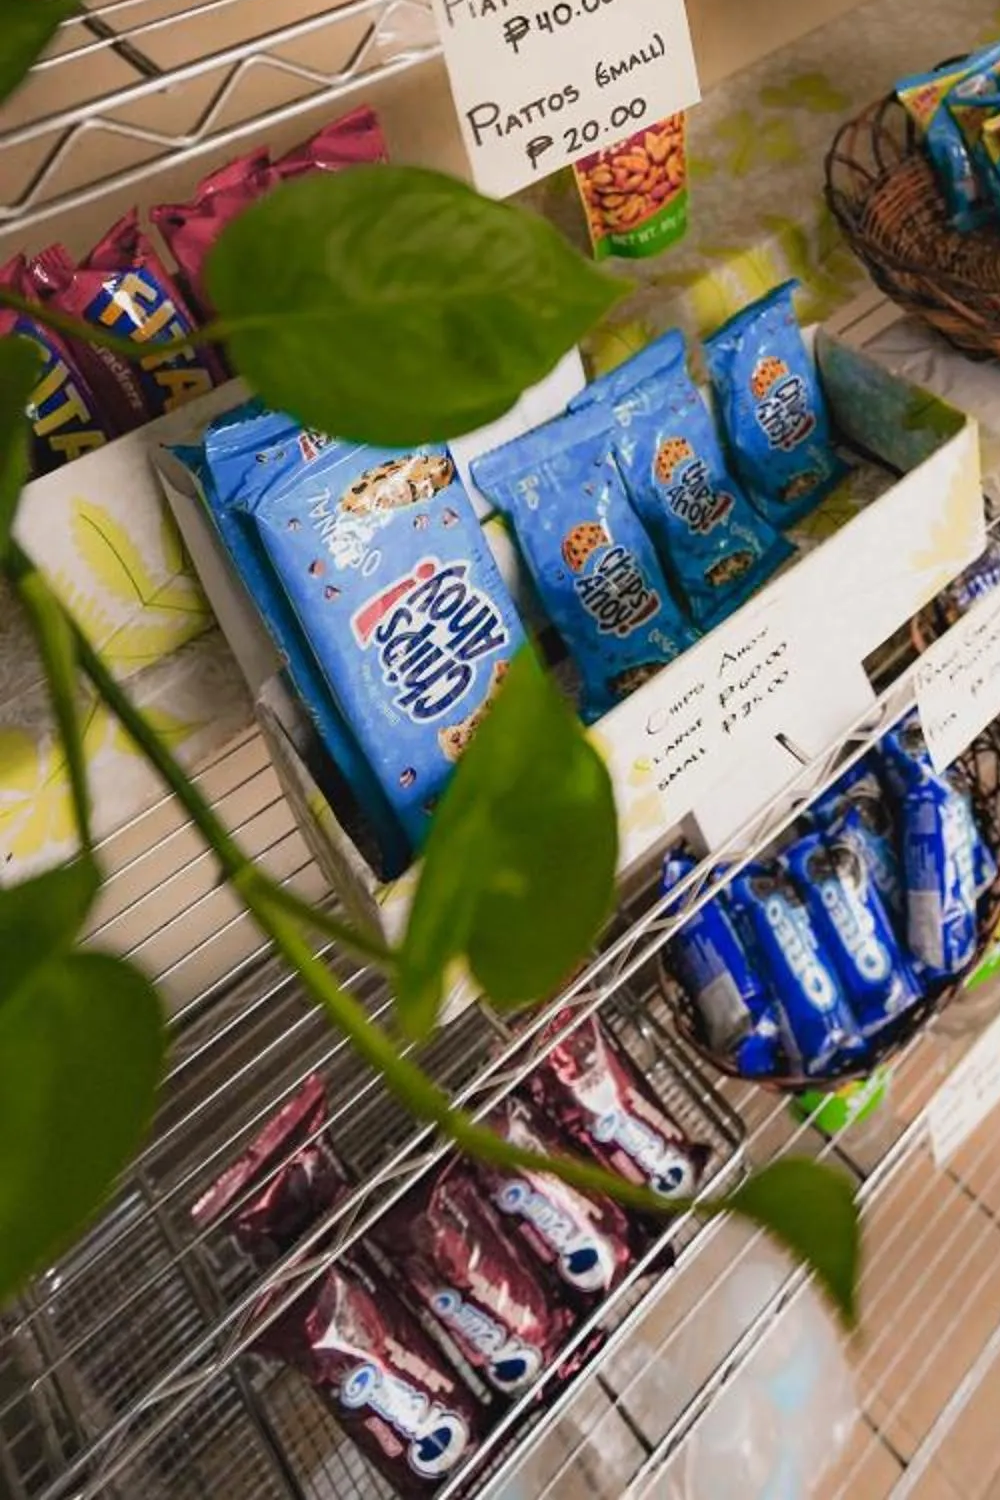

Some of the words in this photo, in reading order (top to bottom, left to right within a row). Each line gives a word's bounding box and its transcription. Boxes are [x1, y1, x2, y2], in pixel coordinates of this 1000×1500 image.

[595, 32, 665, 88] (SMALL)
[354, 562, 505, 661] Ahoy!
[374, 607, 473, 720] Chips
